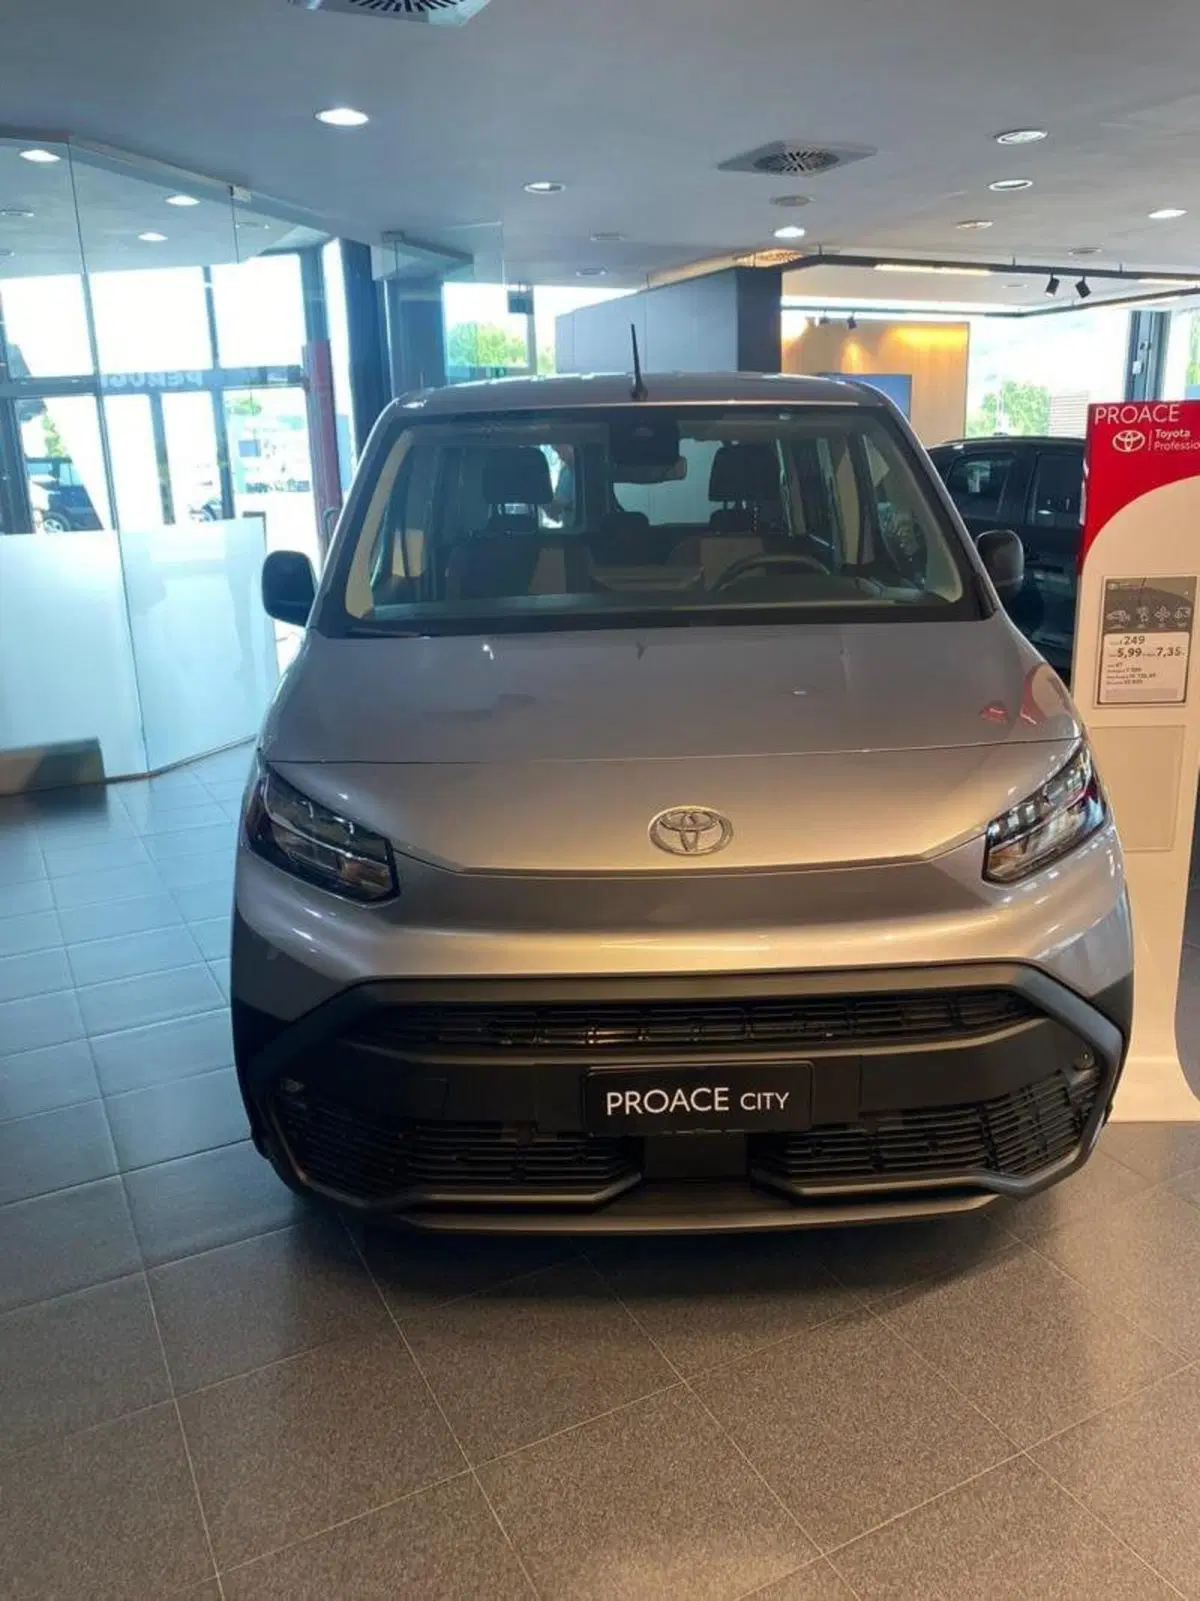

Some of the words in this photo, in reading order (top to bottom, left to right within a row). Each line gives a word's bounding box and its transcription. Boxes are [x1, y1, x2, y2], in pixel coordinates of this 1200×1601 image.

[1094, 403, 1181, 426] PROACE
[1154, 428, 1191, 440] Toyota
[605, 1087, 731, 1116] PROACE
[739, 1091, 791, 1111] CITY
